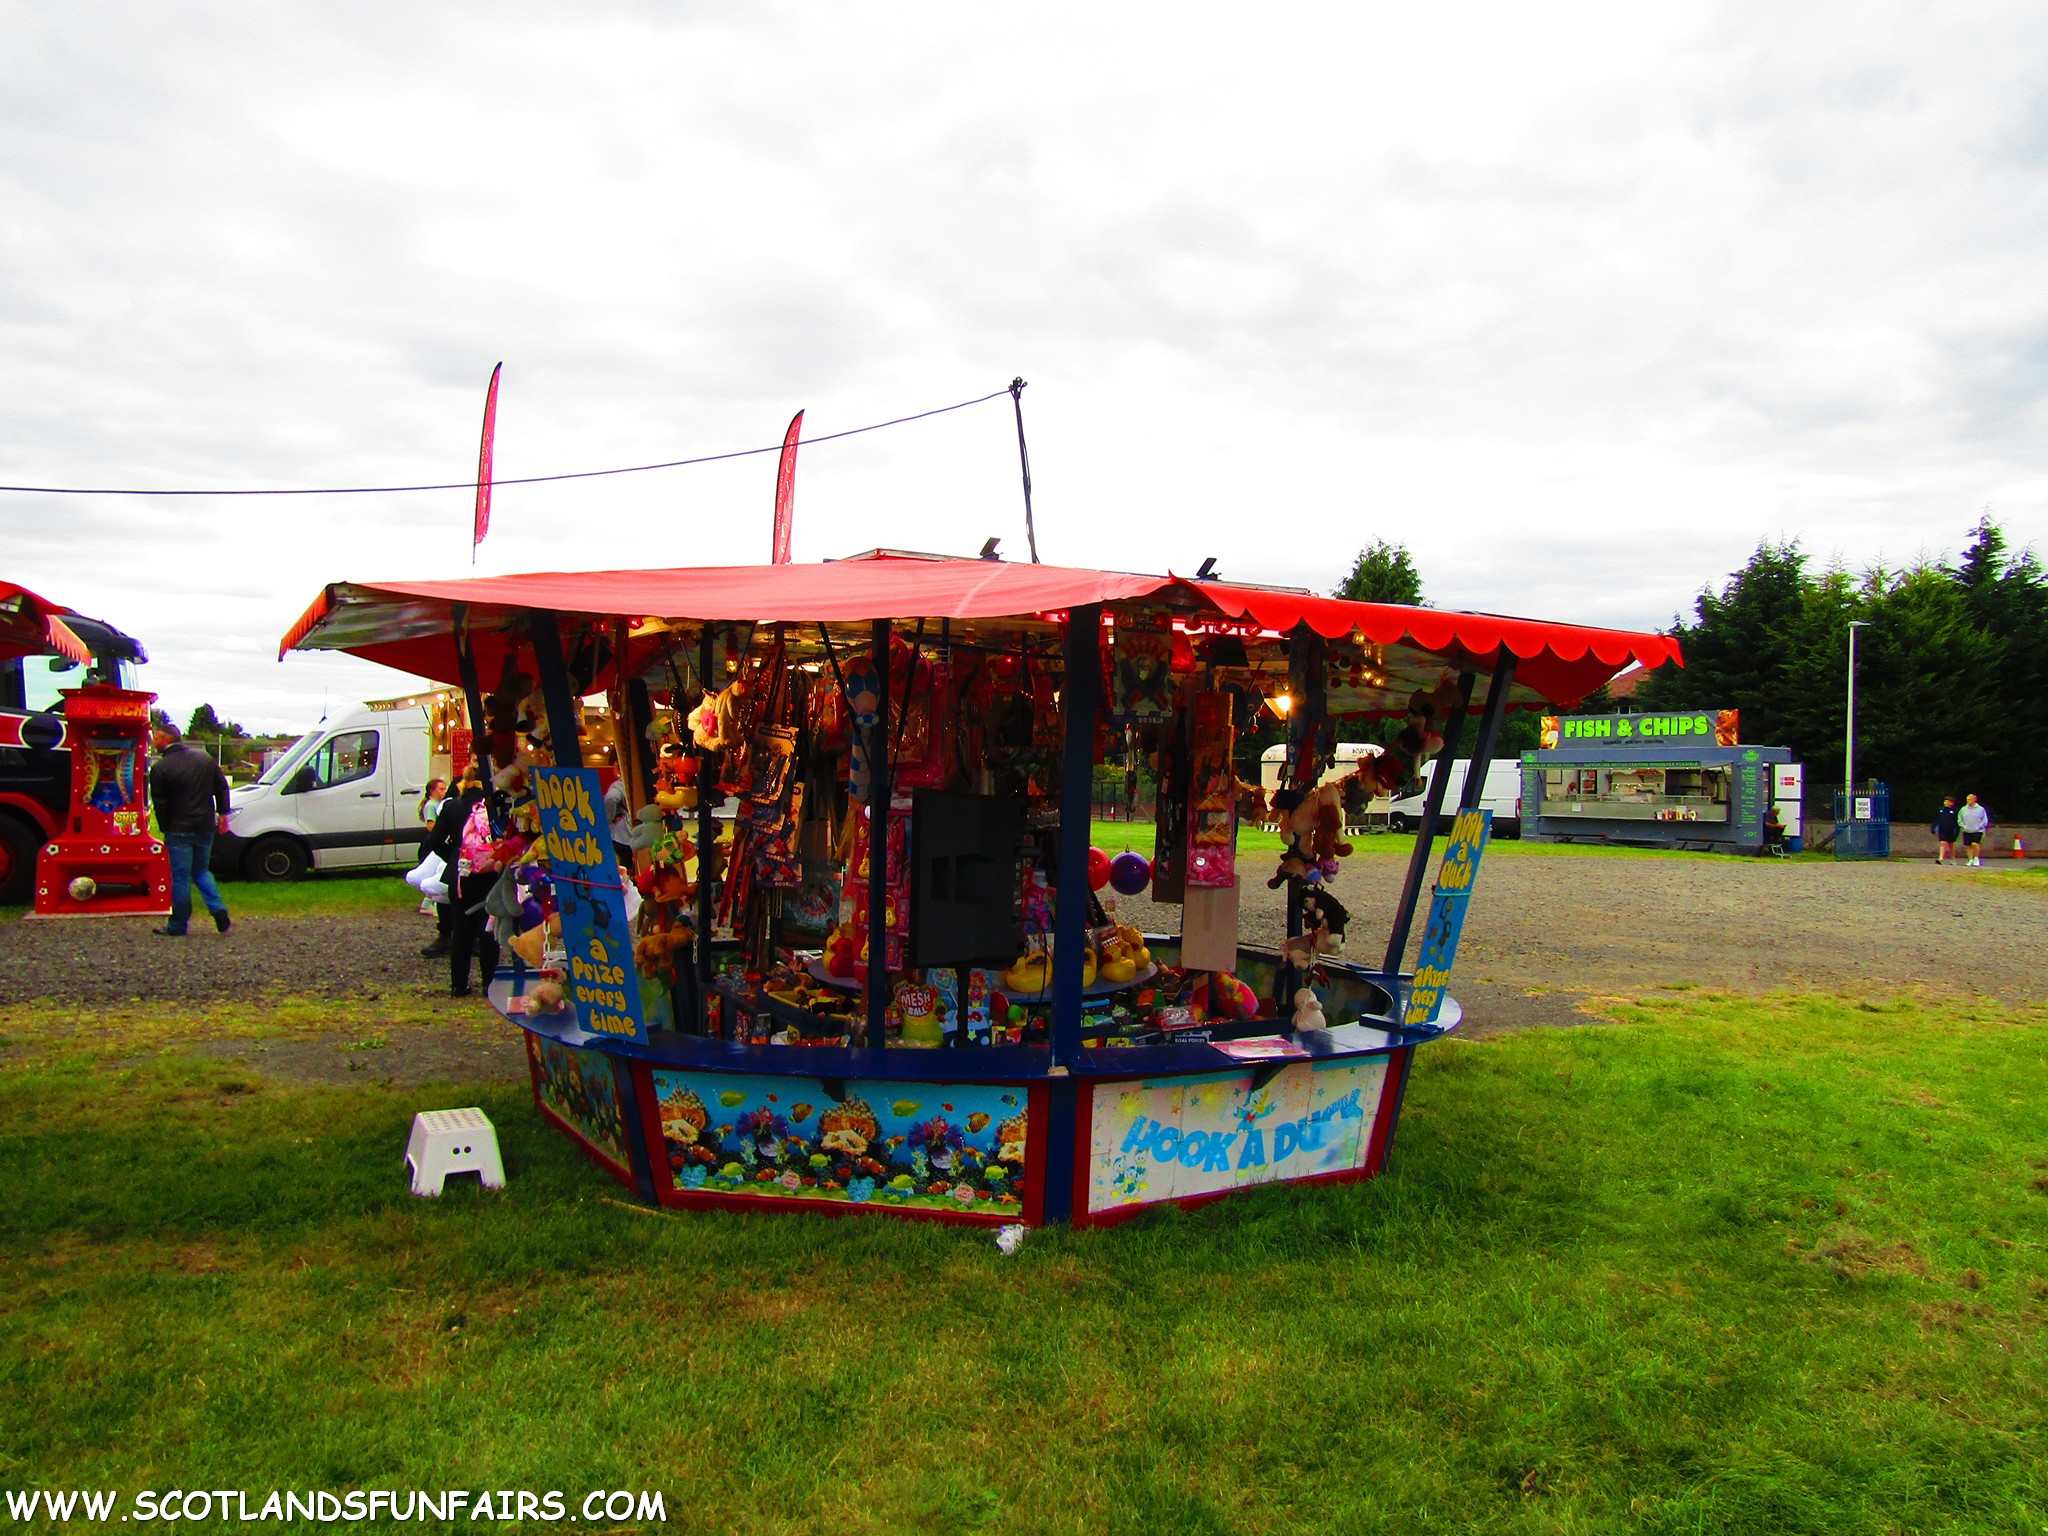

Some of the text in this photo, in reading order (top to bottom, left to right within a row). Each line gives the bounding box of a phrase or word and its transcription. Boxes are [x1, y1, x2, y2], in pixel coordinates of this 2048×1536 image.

[1564, 716, 1709, 738] FISH & CHIPS
[534, 768, 595, 826] hook
[559, 808, 578, 832] a
[1448, 808, 1484, 851] hook
[546, 827, 603, 866] duck
[1457, 841, 1468, 862] a
[1439, 857, 1473, 890] duck
[590, 937, 608, 963] a
[571, 956, 625, 985] Prize
[576, 984, 627, 1012] every
[901, 993, 931, 1006] MESH
[908, 1007, 928, 1016] BALL
[1411, 988, 1438, 1008] every
[590, 1008, 637, 1037] time
[1405, 1006, 1429, 1025] time
[1119, 1115, 1238, 1173] HOOK
[1237, 1129, 1265, 1170] A
